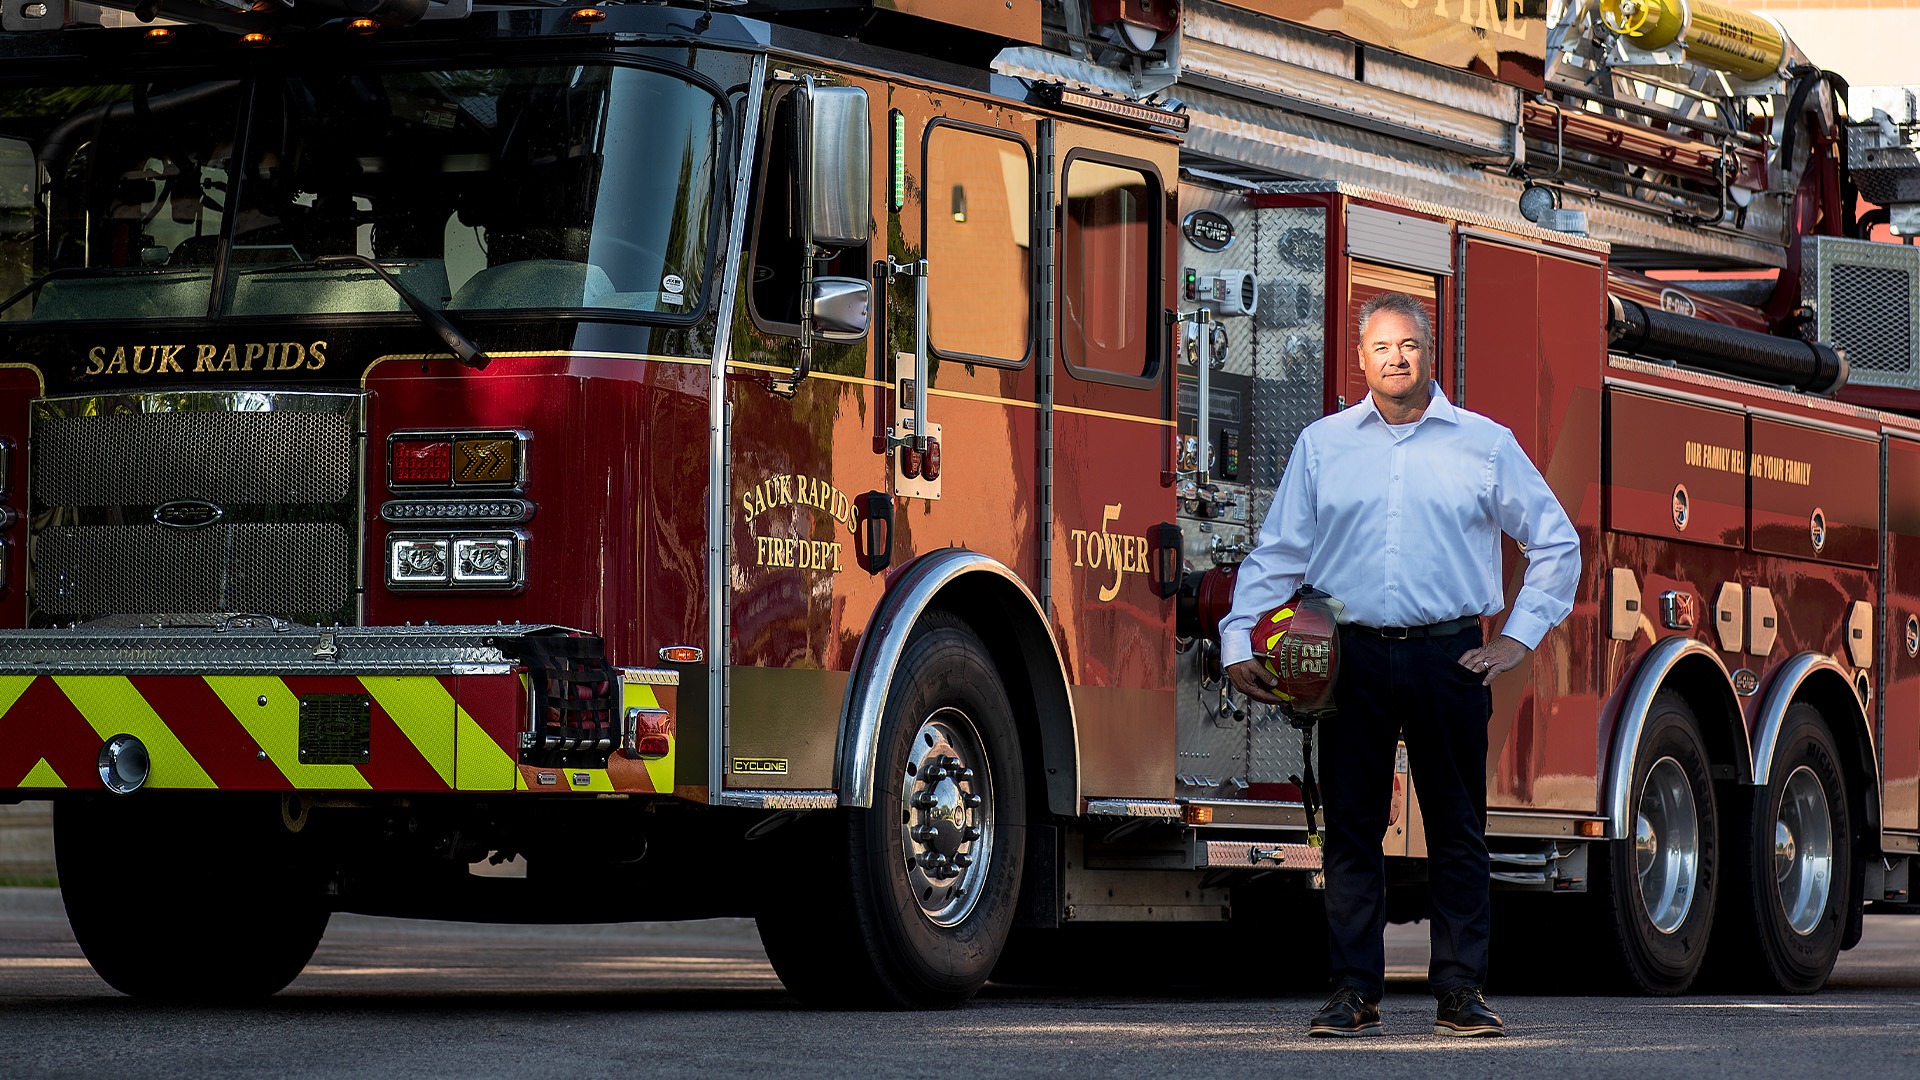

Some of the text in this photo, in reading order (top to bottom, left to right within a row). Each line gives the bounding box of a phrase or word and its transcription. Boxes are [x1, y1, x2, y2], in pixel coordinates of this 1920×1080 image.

[1696, 31, 1766, 64] BREATHING AIR
[1194, 218, 1228, 242] E-ONE
[85, 340, 327, 375] SAUK RAPIDS
[1685, 440, 1811, 486] OUR FAMILY HELNG YOUR FAMILY
[743, 474, 859, 534] SAUK RAPIDS
[756, 536, 843, 572] FIRE DEPT.
[1071, 529, 1150, 574] TOWER
[1098, 502, 1122, 602] 5
[1301, 643, 1321, 673] 22
[735, 761, 786, 771] CYCLONE
[1806, 741, 1845, 841] MICHELIN
[1687, 749, 1712, 891] MICHELIN
